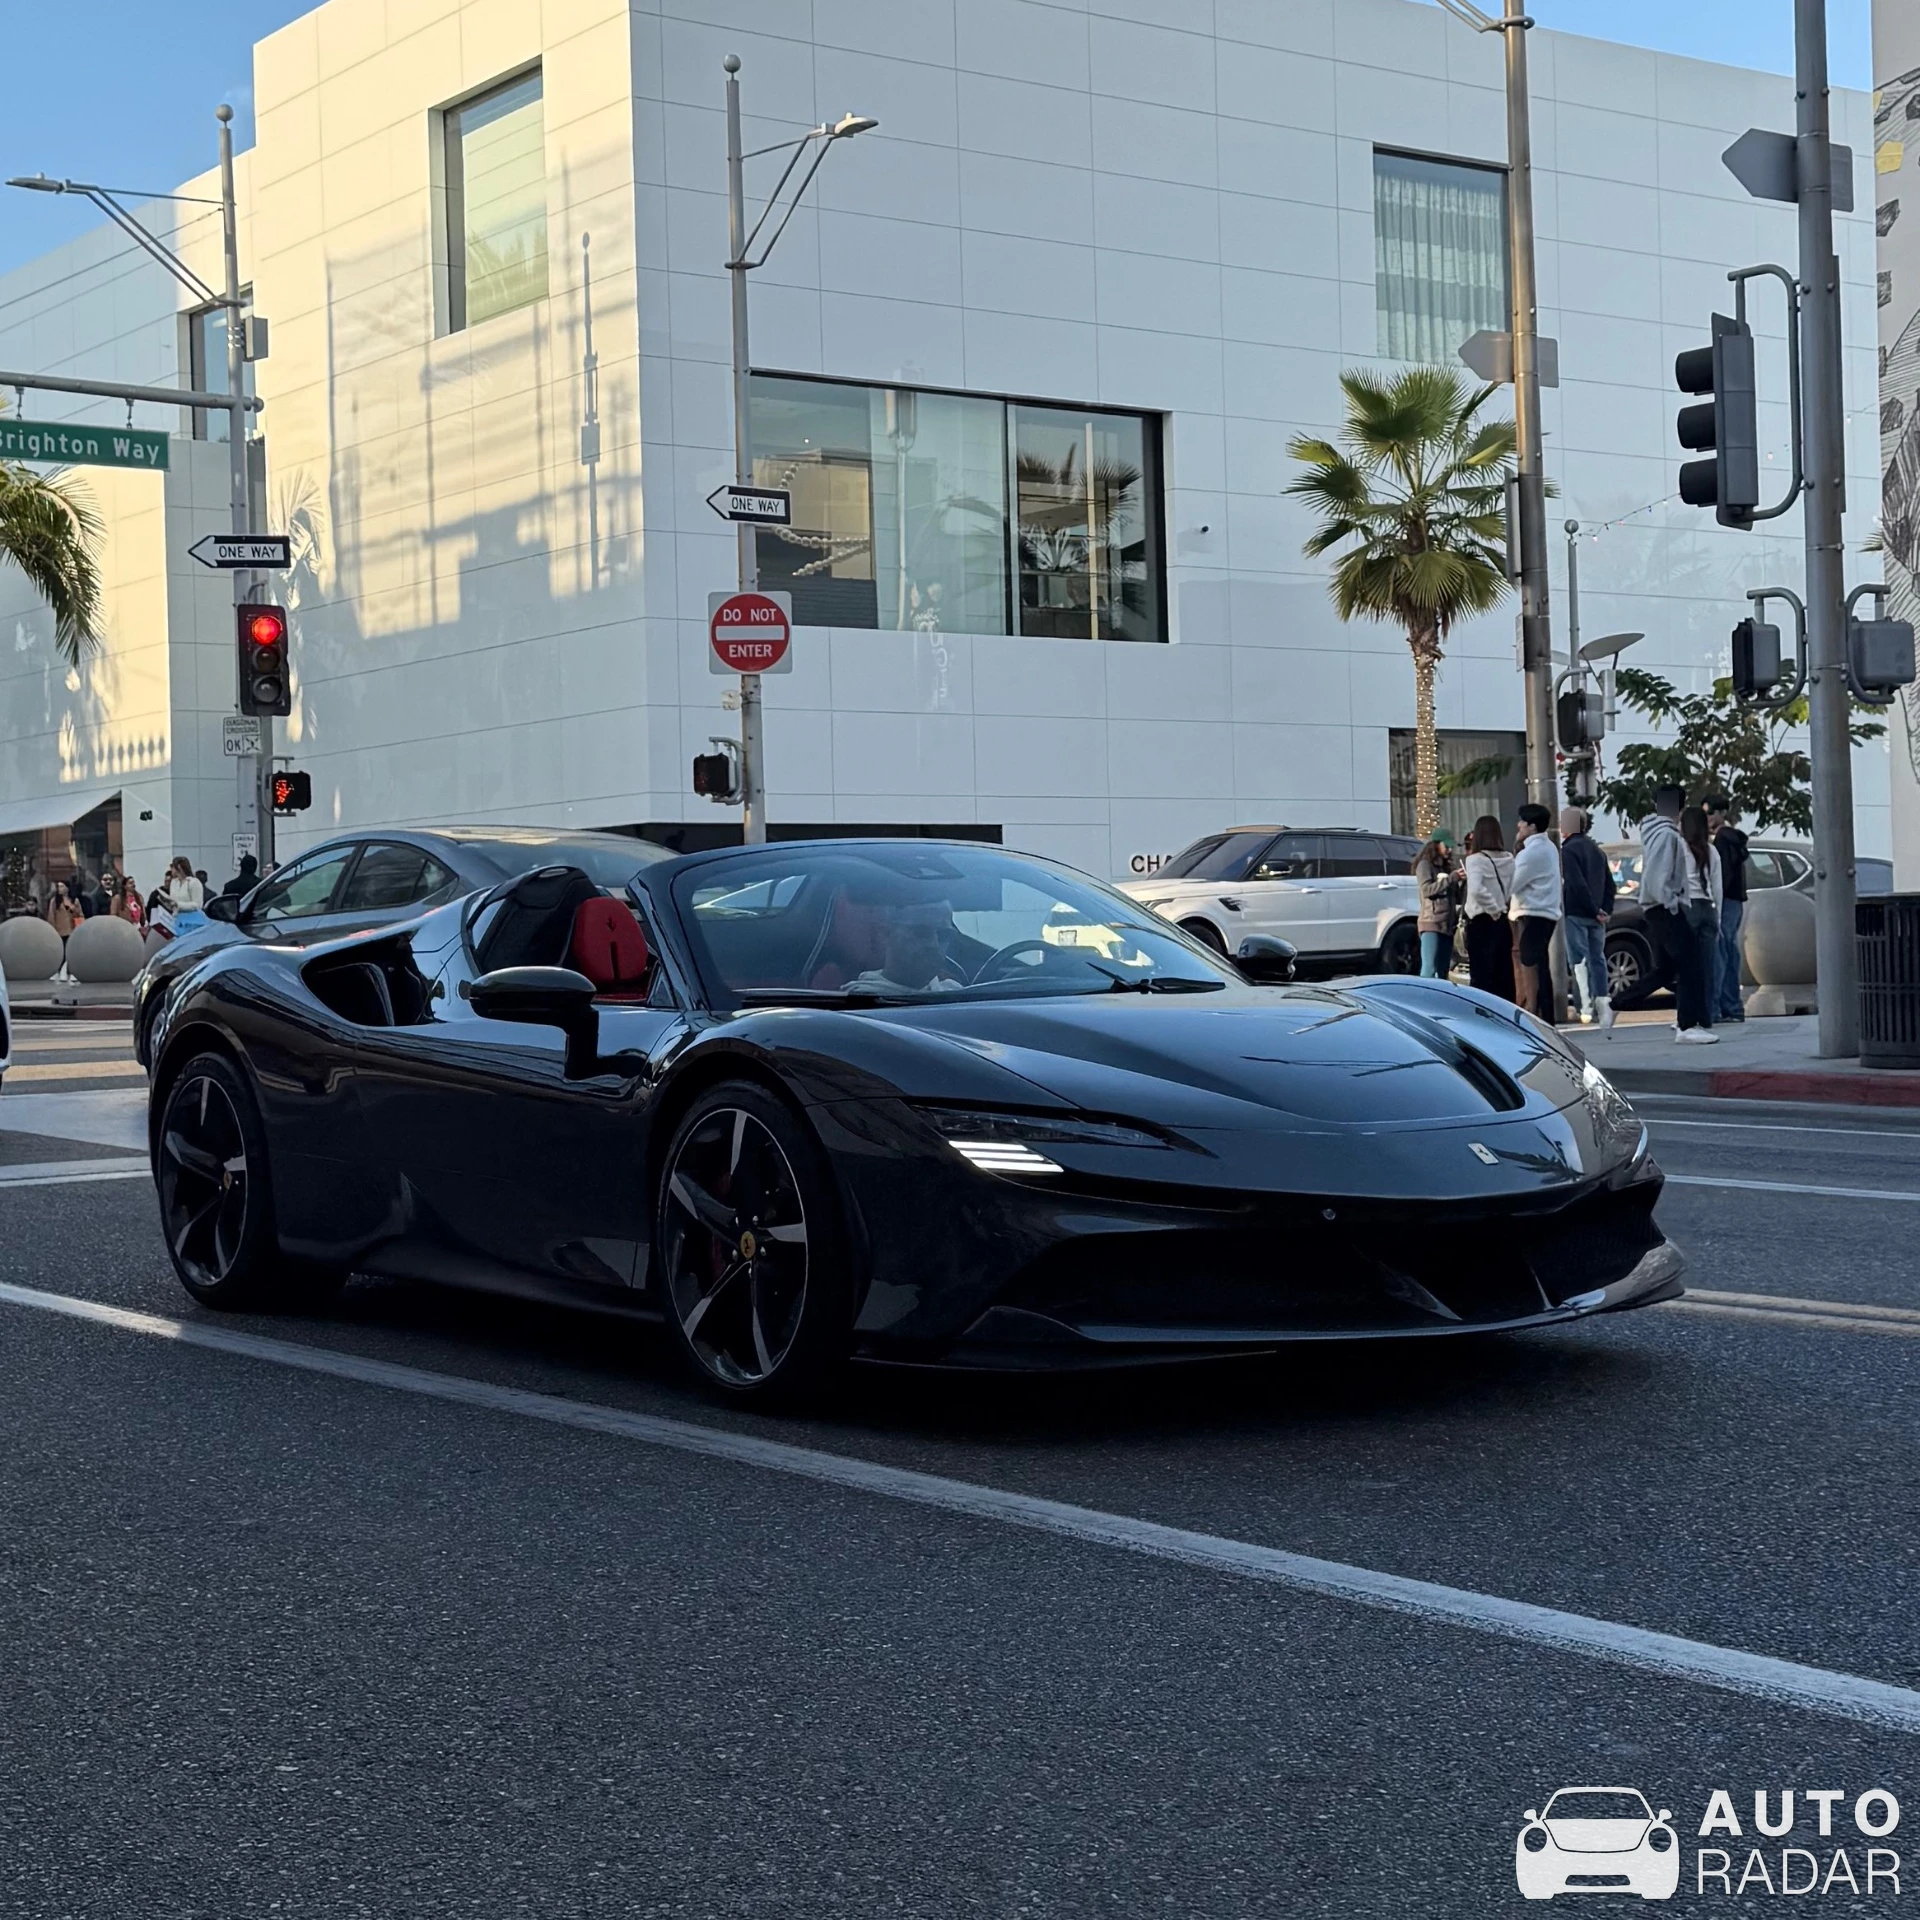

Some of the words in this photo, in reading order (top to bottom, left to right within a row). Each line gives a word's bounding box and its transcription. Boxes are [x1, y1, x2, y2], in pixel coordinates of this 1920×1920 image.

[0, 429, 98, 457] righton
[113, 437, 159, 465] Way
[731, 497, 754, 511] ONE
[758, 499, 780, 513] WAY
[218, 545, 245, 558] ONE
[250, 545, 277, 558] WAY
[723, 609, 742, 622] DO
[750, 608, 777, 622] NOT
[728, 644, 773, 658] ENTER
[226, 739, 241, 752] OK
